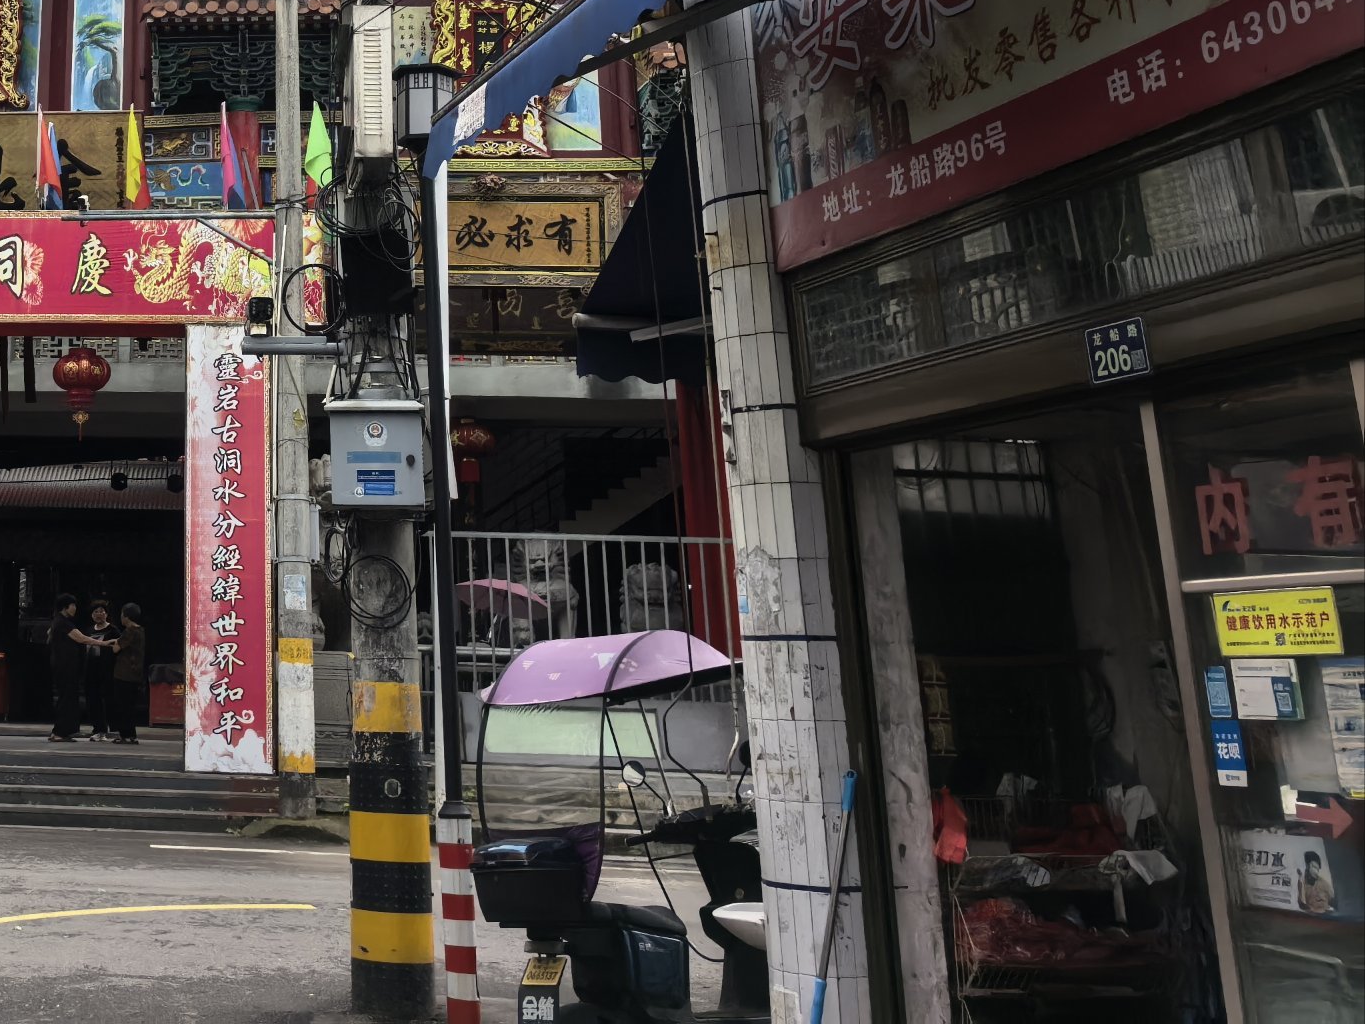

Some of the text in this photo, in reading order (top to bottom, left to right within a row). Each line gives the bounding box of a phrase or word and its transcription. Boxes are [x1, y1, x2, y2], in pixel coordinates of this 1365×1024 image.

[417, 214, 577, 256] 有求必
[1092, 323, 1138, 347] 龙船路
[1094, 344, 1132, 376] 206
[210, 352, 247, 746] 靈岩古洞水分經緯世界和平
[1226, 611, 1331, 632] 健康饮用水示范户
[1216, 742, 1242, 760] 花呗
[522, 995, 555, 1021] 金箭
